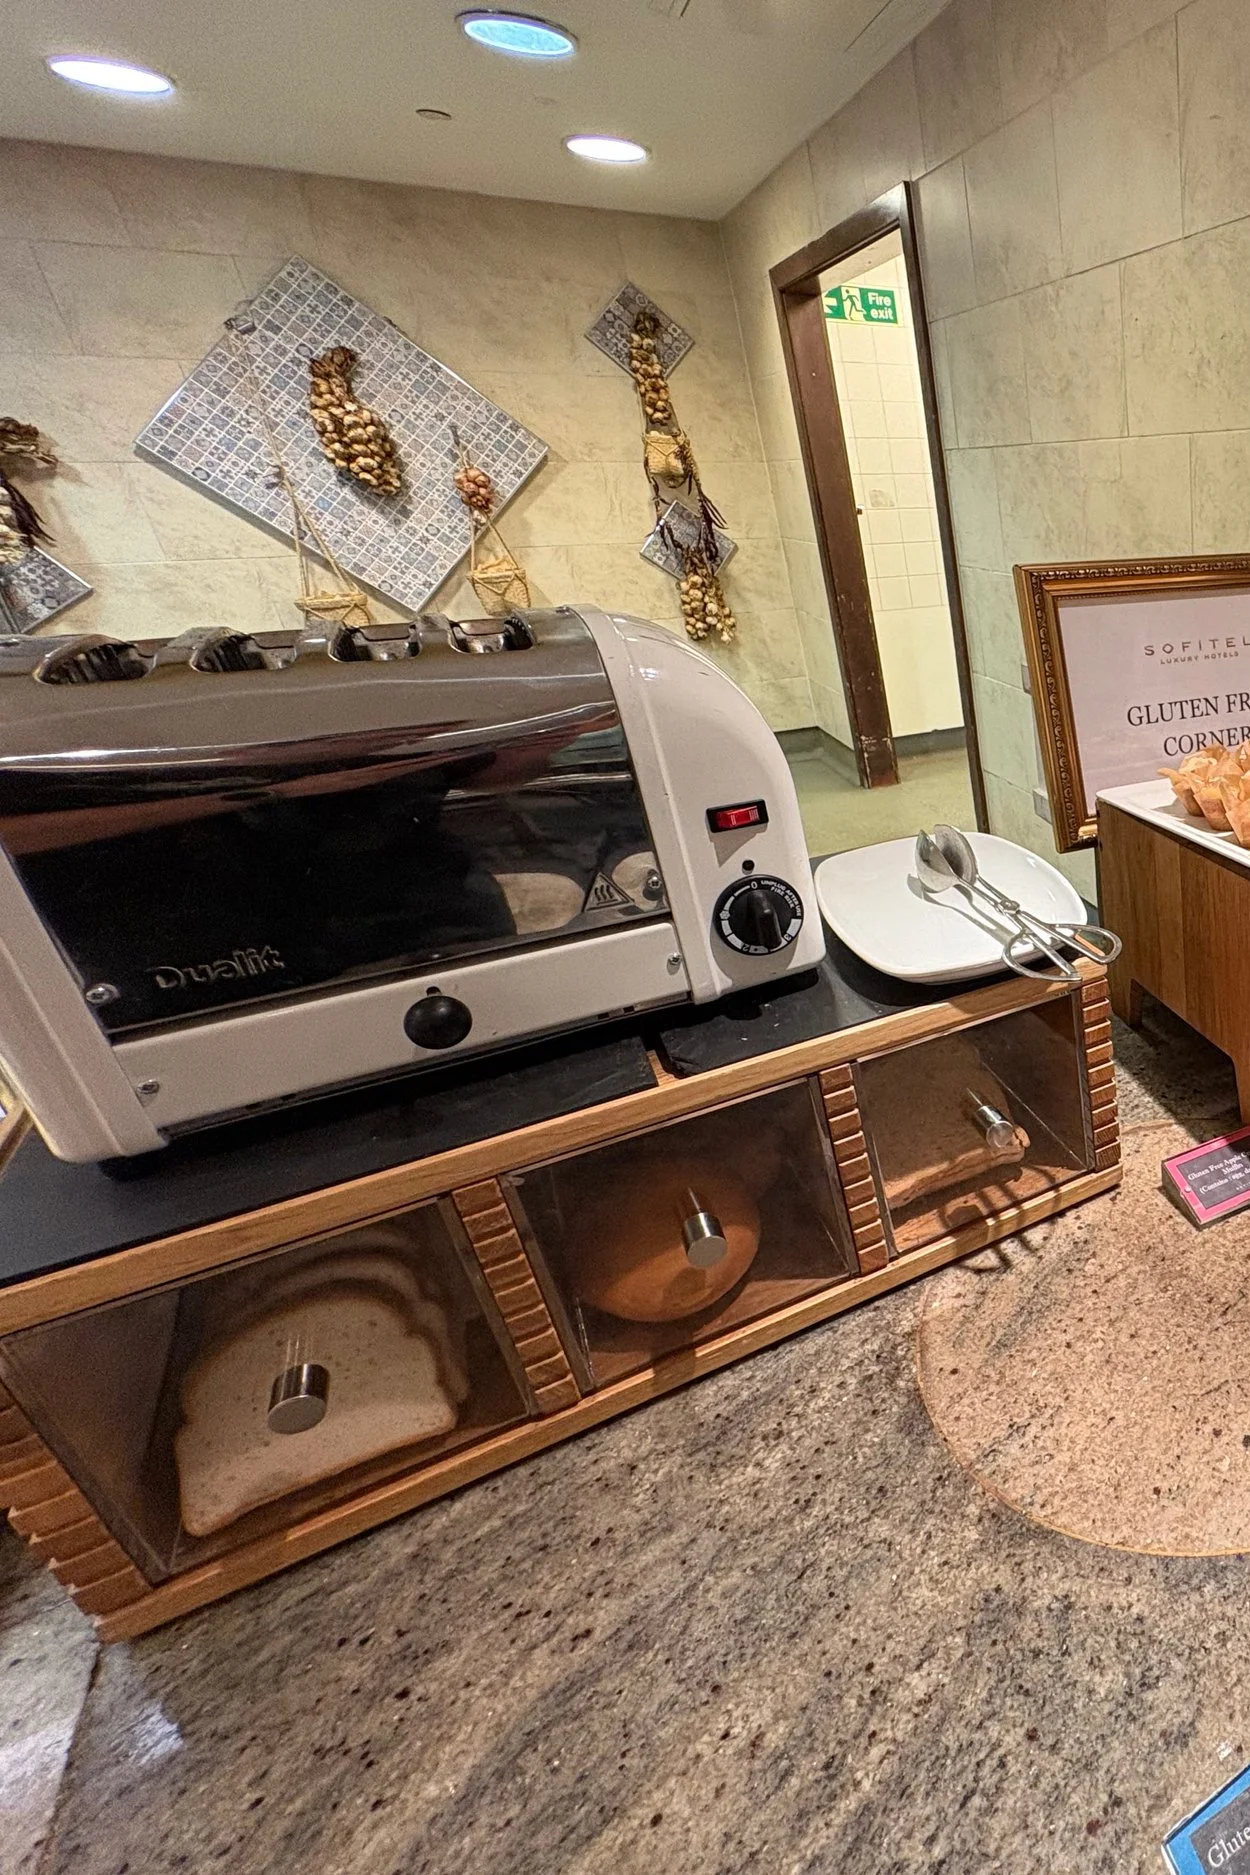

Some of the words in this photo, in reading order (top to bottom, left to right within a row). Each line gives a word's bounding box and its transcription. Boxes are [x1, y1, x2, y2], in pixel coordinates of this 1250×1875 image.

[867, 292, 892, 306] Fire
[870, 308, 894, 320] exit
[1160, 655, 1199, 665] LUXURY
[1204, 651, 1239, 660] HOTELS
[1127, 695, 1219, 727] GLUTEN
[761, 880, 786, 890] UNPLUG
[785, 889, 799, 906] AFTER
[771, 886, 785, 897] FIRE
[784, 895, 794, 908] RISK
[1188, 1168, 1210, 1180] Gluten
[1209, 1162, 1224, 1172] Free
[1224, 1154, 1242, 1165] Apple
[1222, 1163, 1244, 1175] Muffin
